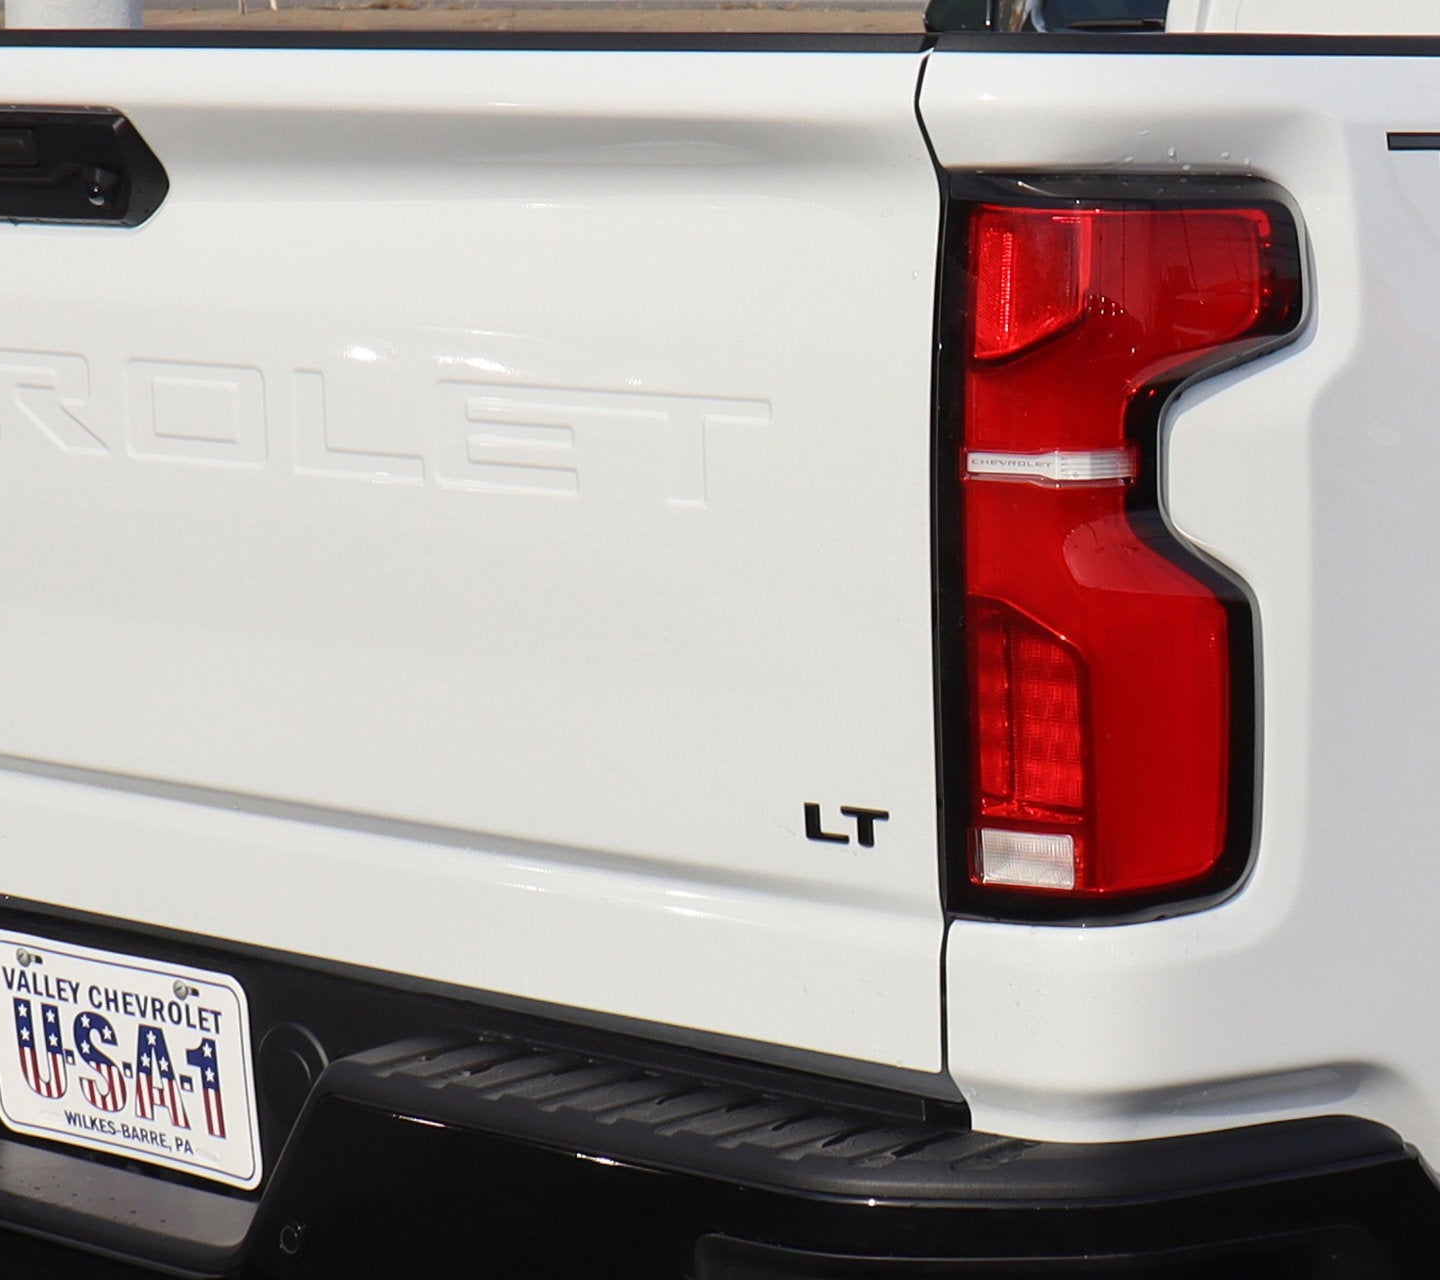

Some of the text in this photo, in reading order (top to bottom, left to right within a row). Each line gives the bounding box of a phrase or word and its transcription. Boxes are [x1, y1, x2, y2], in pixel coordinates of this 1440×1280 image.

[971, 458, 1053, 469] CHEVROLET
[803, 801, 890, 848] LT
[1, 966, 223, 1035] VALLEY CHEVROLET
[63, 1110, 196, 1156] WILKES-BARRE, PA
